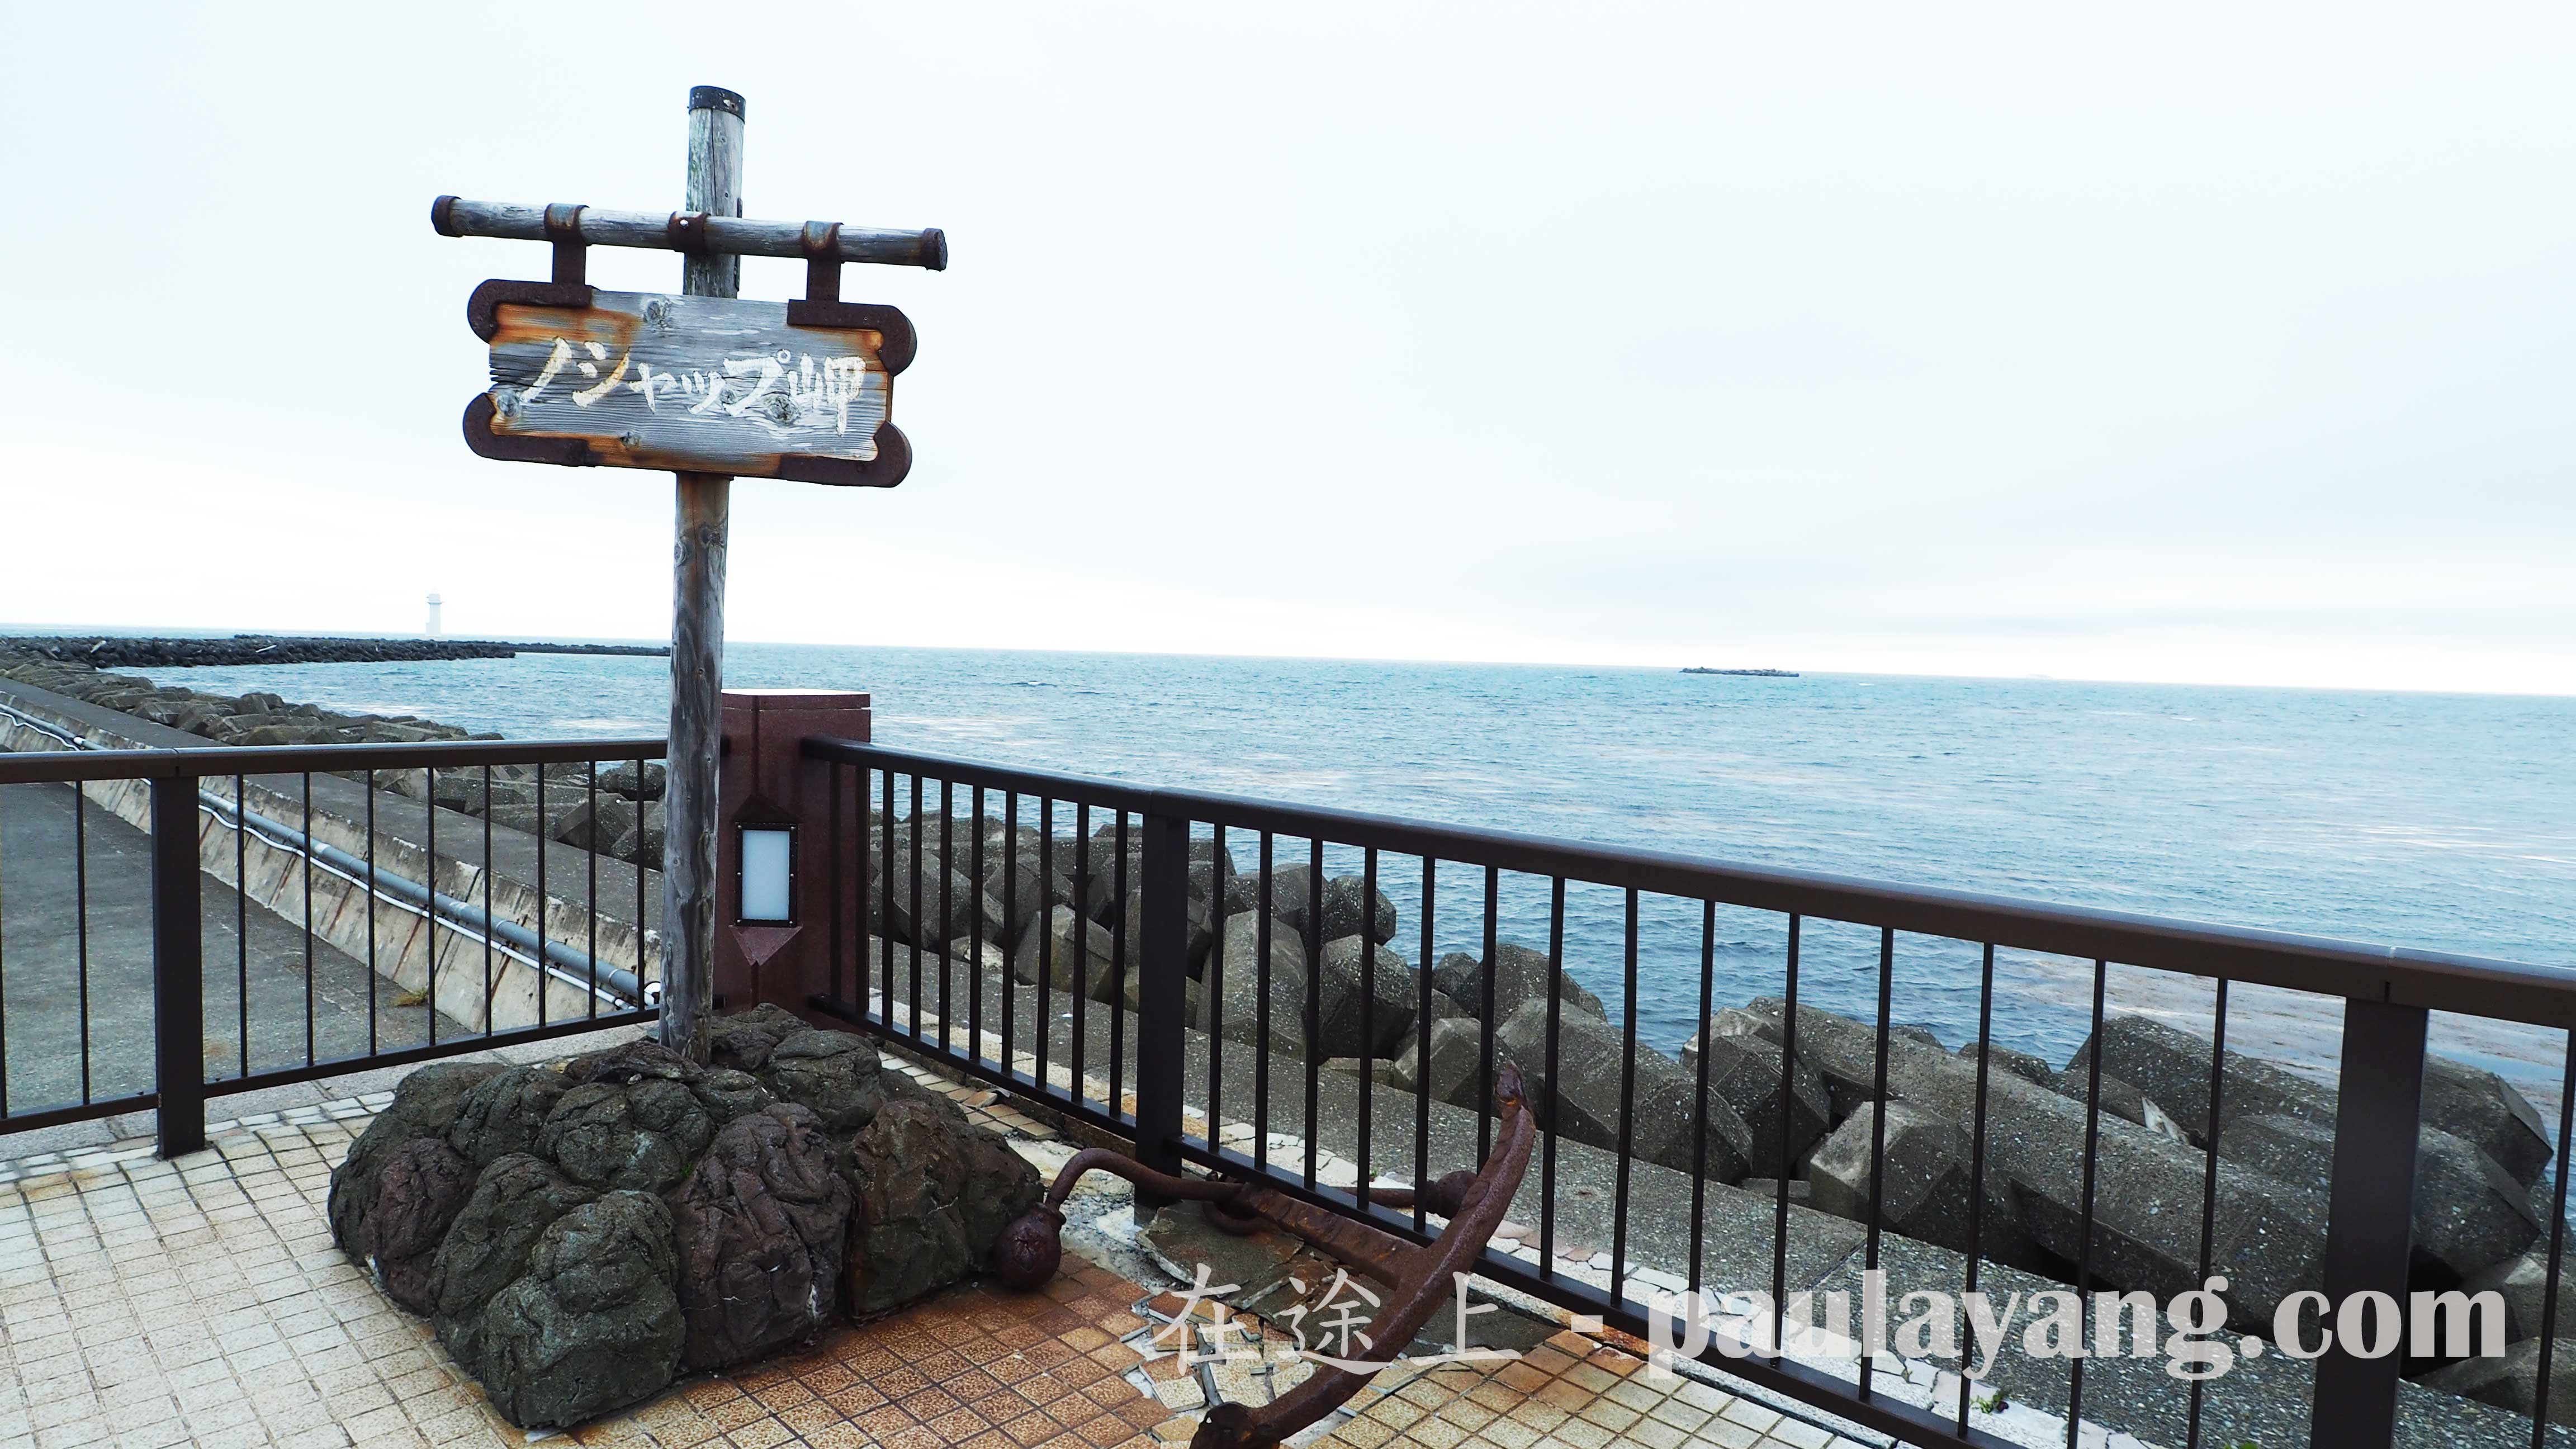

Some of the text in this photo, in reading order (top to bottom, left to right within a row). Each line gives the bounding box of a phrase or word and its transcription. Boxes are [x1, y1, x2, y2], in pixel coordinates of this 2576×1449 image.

[518, 338, 866, 437] ノシャップ岬
